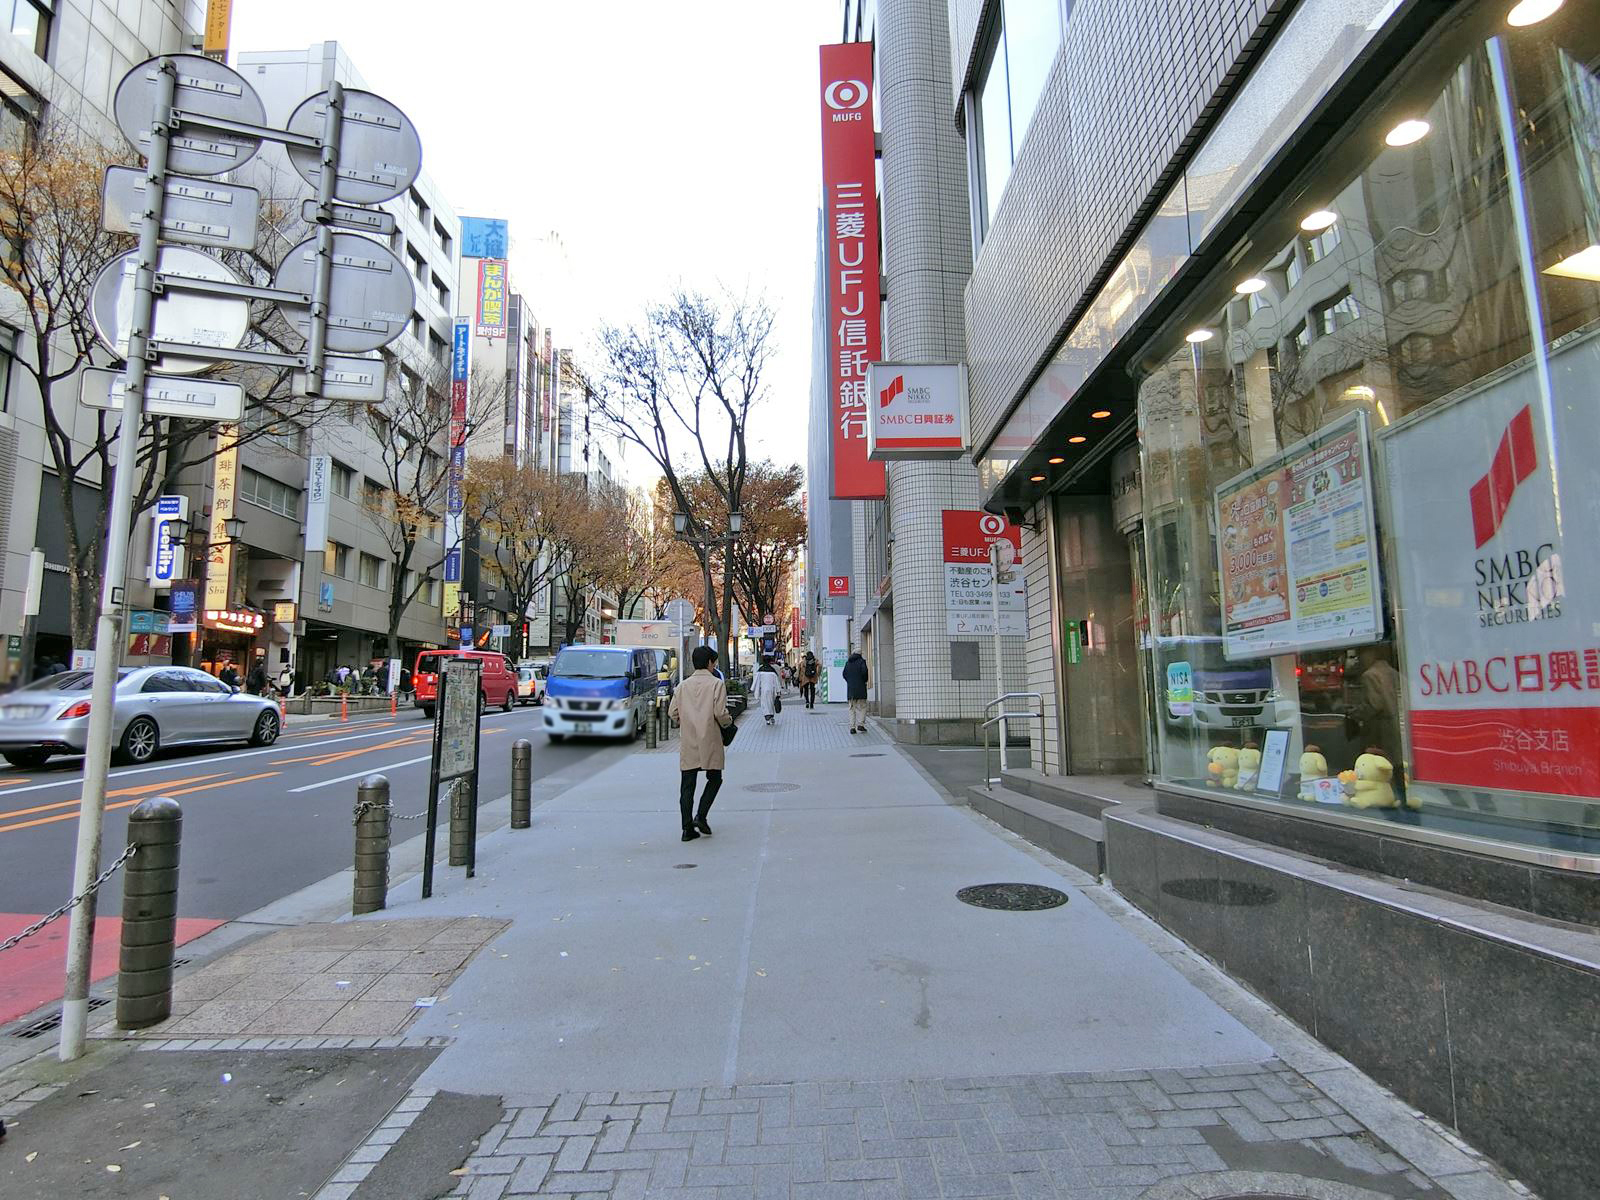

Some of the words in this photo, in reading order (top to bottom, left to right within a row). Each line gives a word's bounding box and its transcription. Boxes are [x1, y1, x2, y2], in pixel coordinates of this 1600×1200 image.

[832, 113, 862, 123] MUFG
[837, 183, 868, 439] 三菱UFJ信託銀行
[907, 387, 930, 395] SMBC
[880, 414, 955, 425] SMBC日興証券
[44, 561, 71, 574] SHIBUY
[1474, 543, 1554, 588] SMBC
[950, 590, 964, 598] TEL
[973, 624, 1019, 633] ATMーナー
[1170, 671, 1189, 685] NISA
[1498, 728, 1569, 752] 渋谷支店
[1492, 758, 1537, 775] Shibuya
[1540, 760, 1584, 776] Branch
